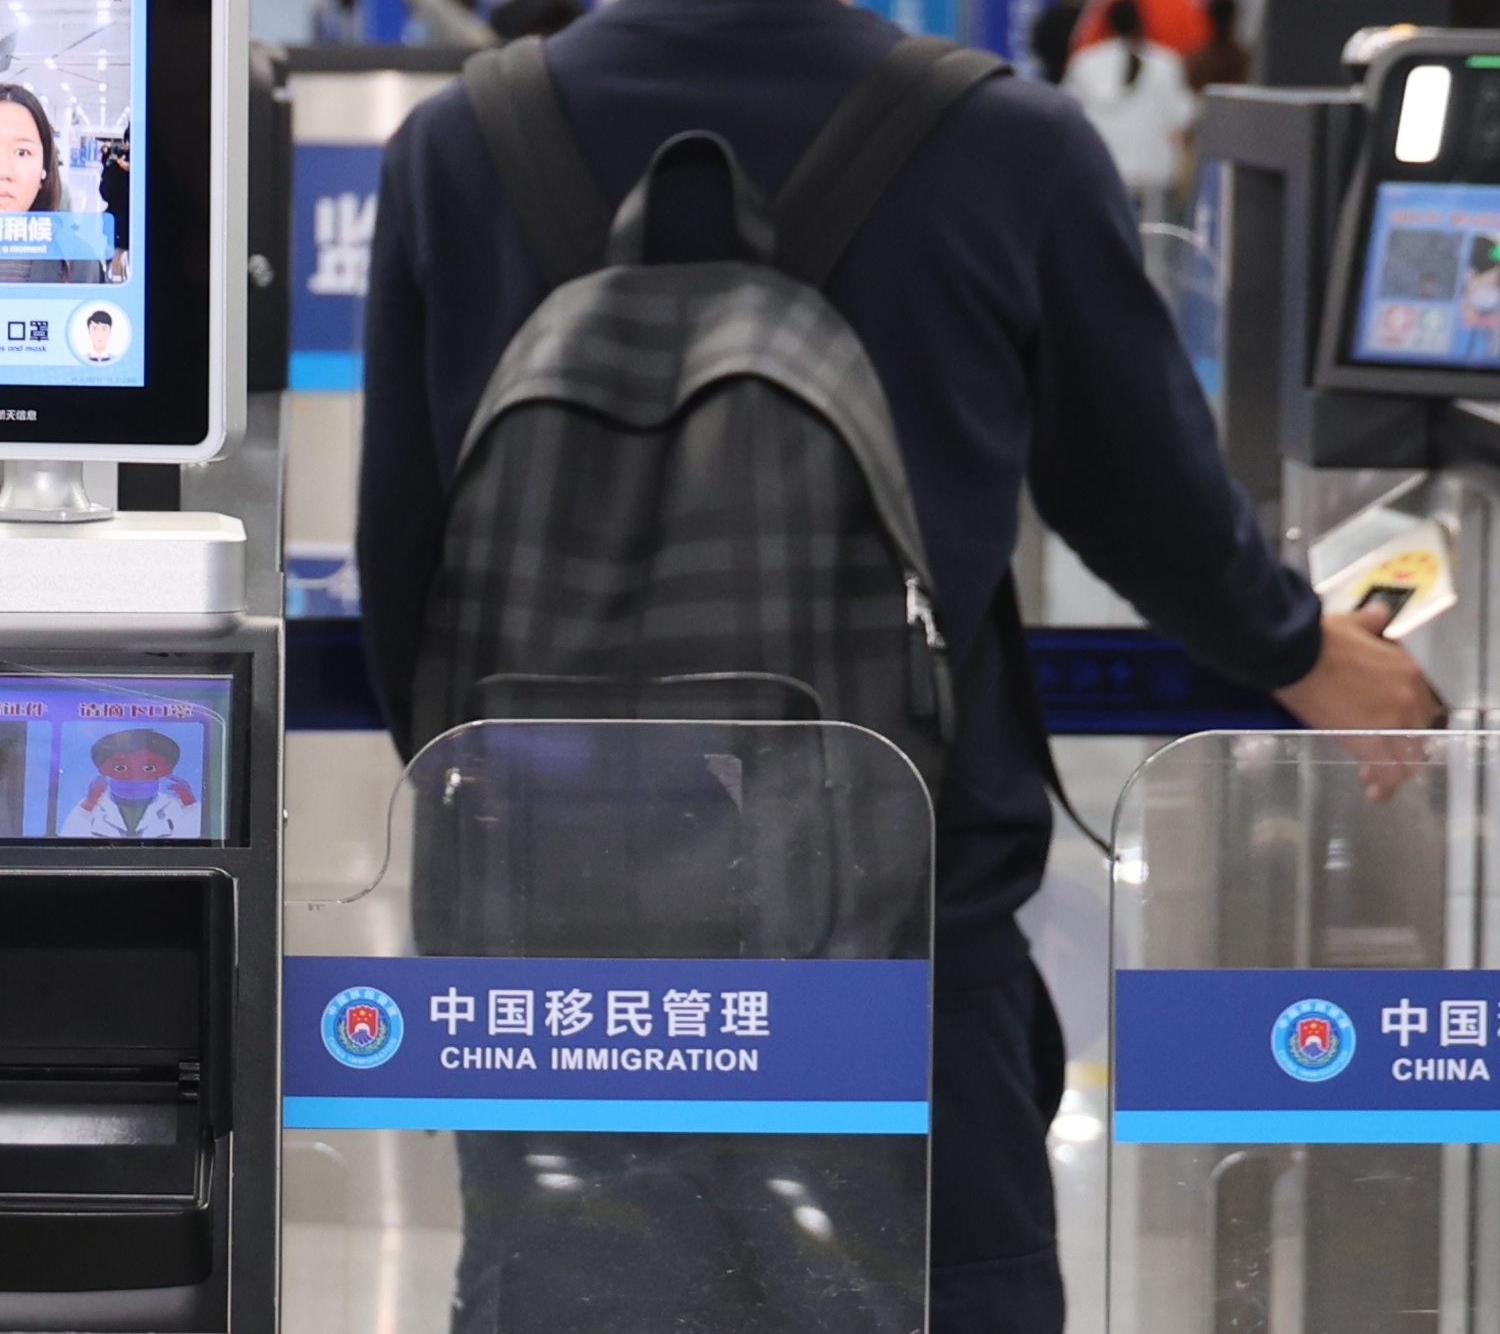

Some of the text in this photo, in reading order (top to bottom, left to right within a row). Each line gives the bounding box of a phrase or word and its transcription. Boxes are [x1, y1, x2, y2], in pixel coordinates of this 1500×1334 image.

[430, 987, 770, 1037] 中国移民管理
[440, 1047, 758, 1071] CHINA IMMIGRATION
[1392, 1058, 1490, 1081] CHINA
